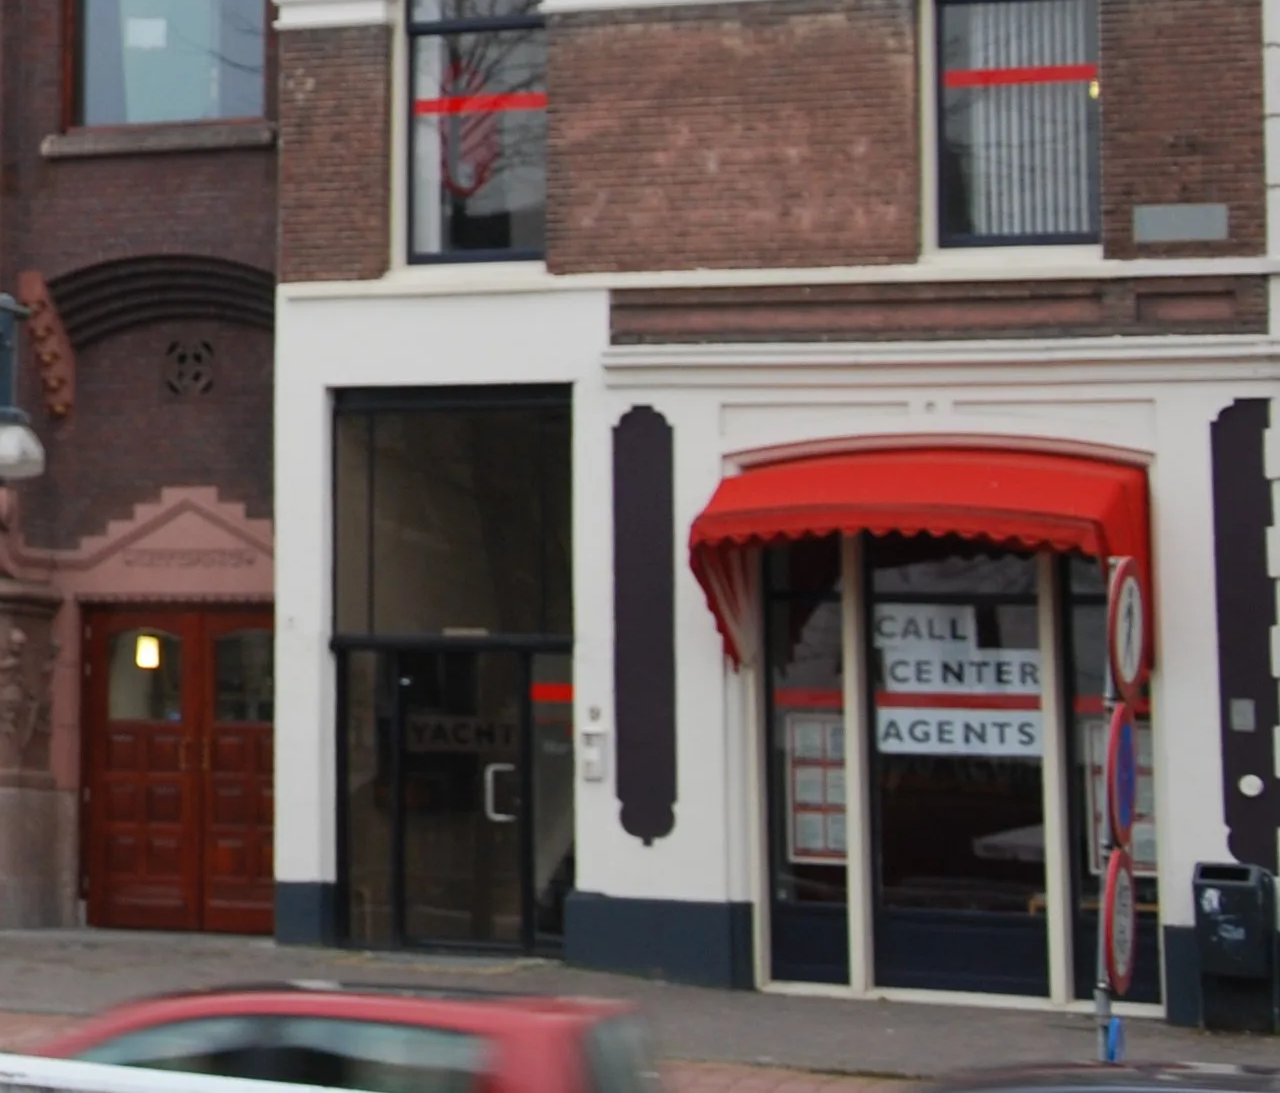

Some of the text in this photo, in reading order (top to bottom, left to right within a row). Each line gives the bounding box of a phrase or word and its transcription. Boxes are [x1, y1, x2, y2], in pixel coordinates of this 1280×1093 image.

[876, 615, 968, 642] CALL
[889, 660, 1040, 685] CENTER
[410, 720, 518, 747] YACHT
[882, 720, 1036, 745] AGENTS
